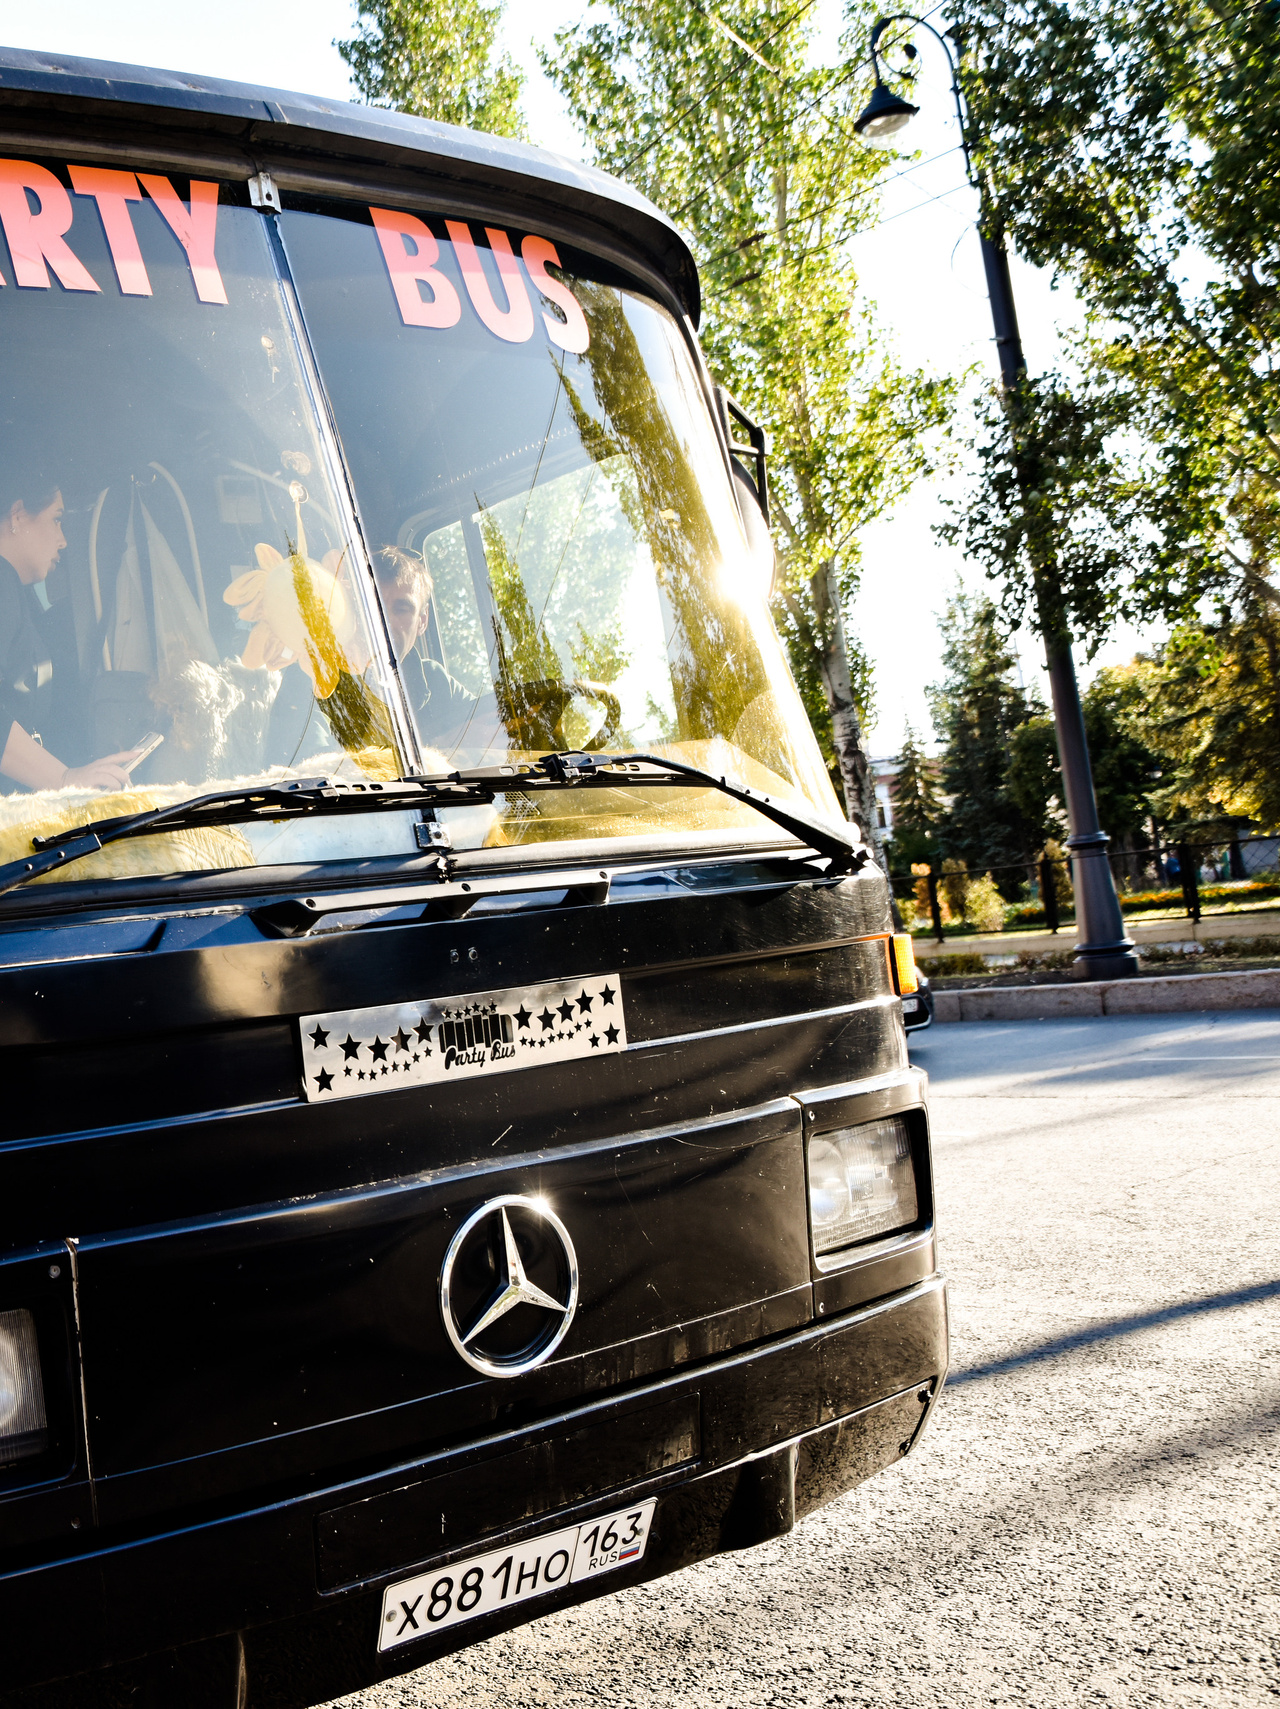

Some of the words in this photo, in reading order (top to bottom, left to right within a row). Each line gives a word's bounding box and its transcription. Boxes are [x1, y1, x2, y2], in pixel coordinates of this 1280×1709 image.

[369, 207, 590, 354] BUS
[445, 1047, 486, 1070] Party
[490, 1040, 516, 1062] Bus
[583, 1512, 643, 1557] 163
[588, 1551, 619, 1571] RUS
